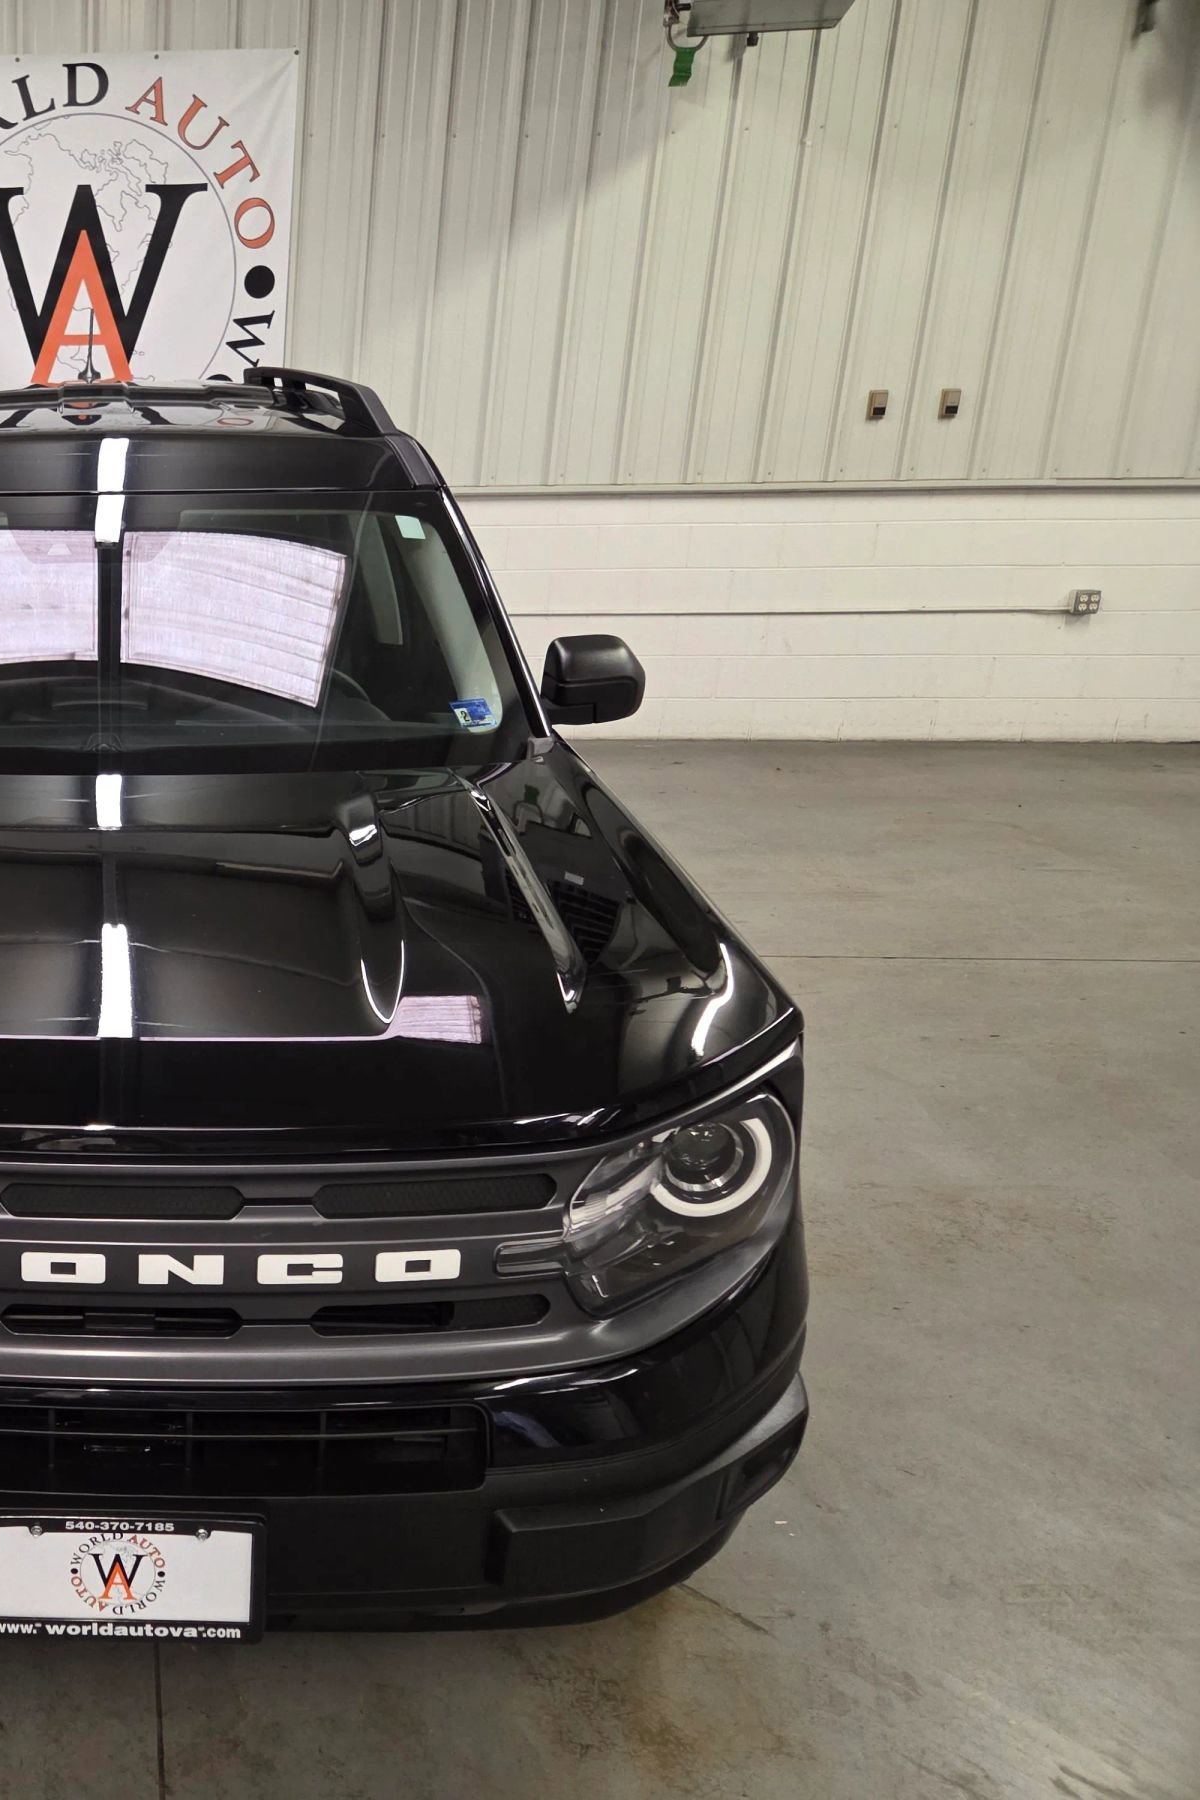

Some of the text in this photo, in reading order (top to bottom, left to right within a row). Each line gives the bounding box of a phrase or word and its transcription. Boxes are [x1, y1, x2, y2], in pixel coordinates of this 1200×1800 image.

[125, 76, 275, 249] AUTO
[65, 1521, 175, 1532] 540-370-7185
[70, 1533, 165, 1568] WORLD AUTO
